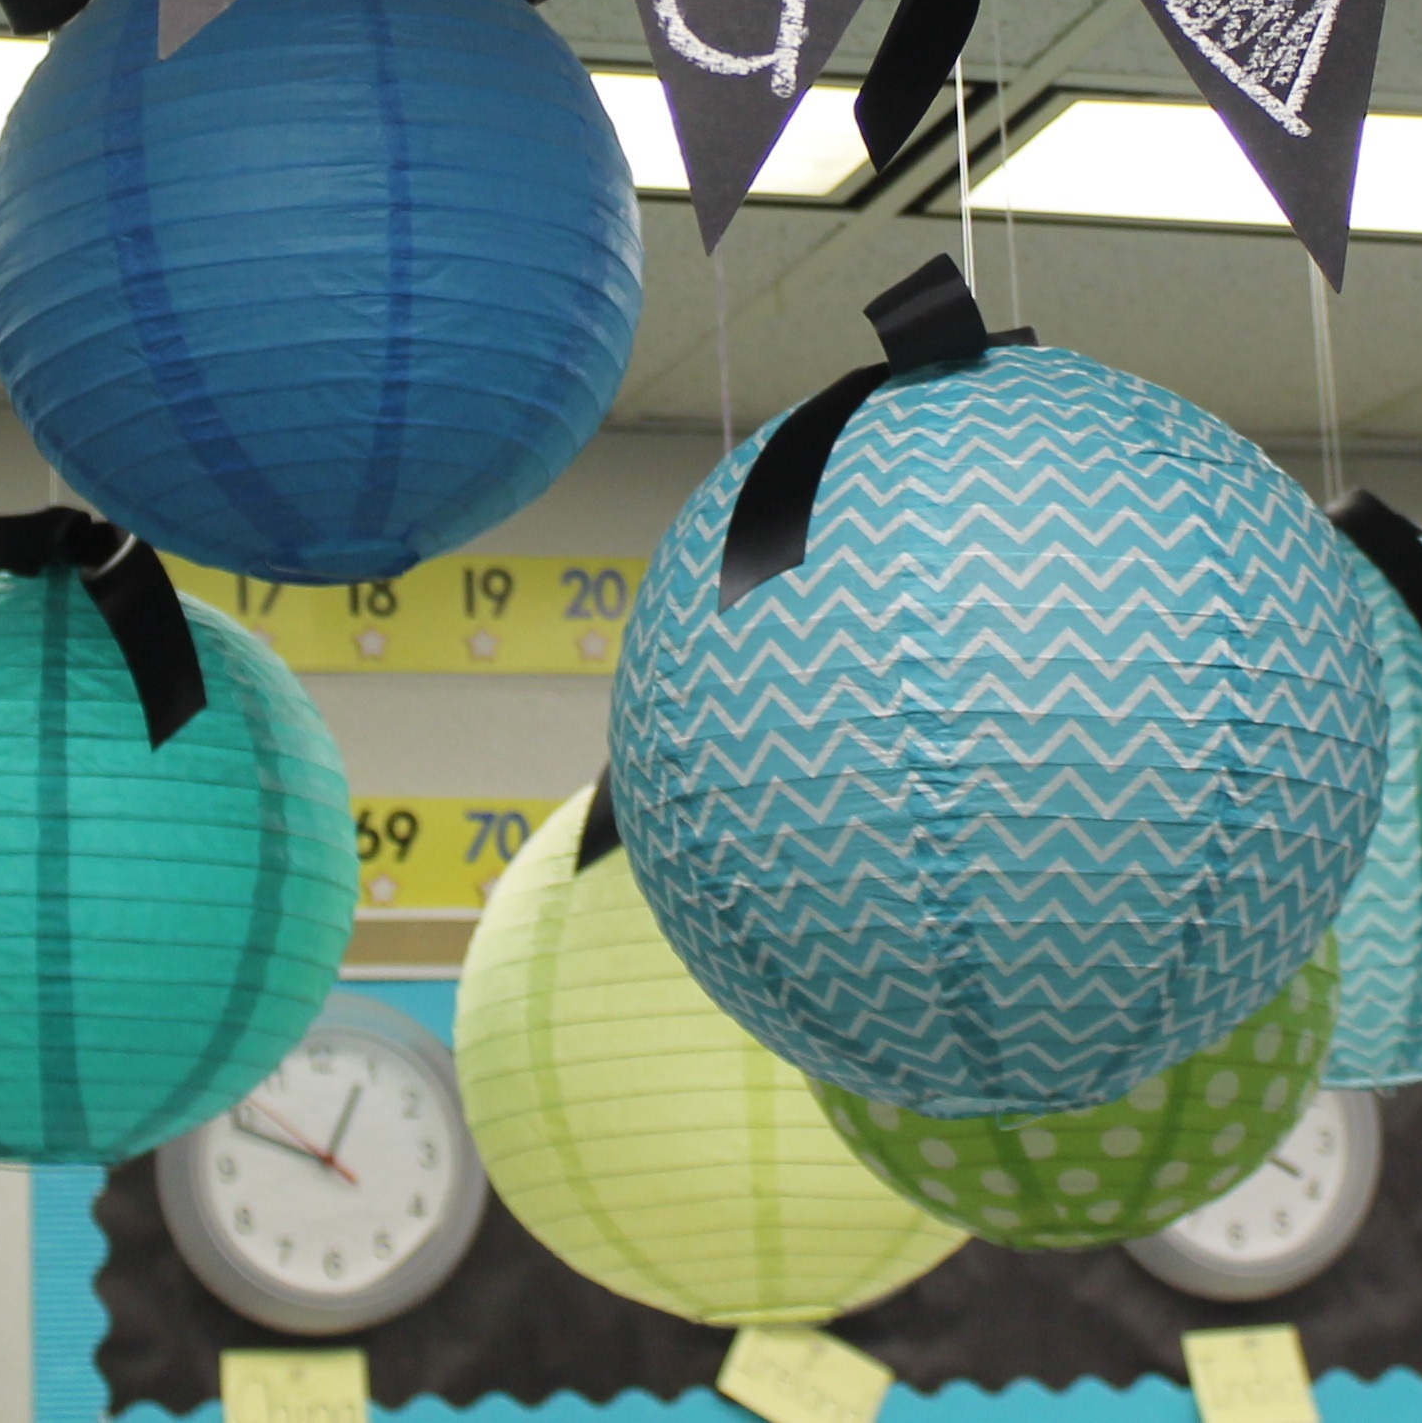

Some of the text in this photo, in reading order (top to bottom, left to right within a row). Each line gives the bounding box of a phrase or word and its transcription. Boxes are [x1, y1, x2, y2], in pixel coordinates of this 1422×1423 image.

[463, 567, 513, 619] 19
[560, 568, 627, 620] 20
[356, 809, 530, 863] 69 70
